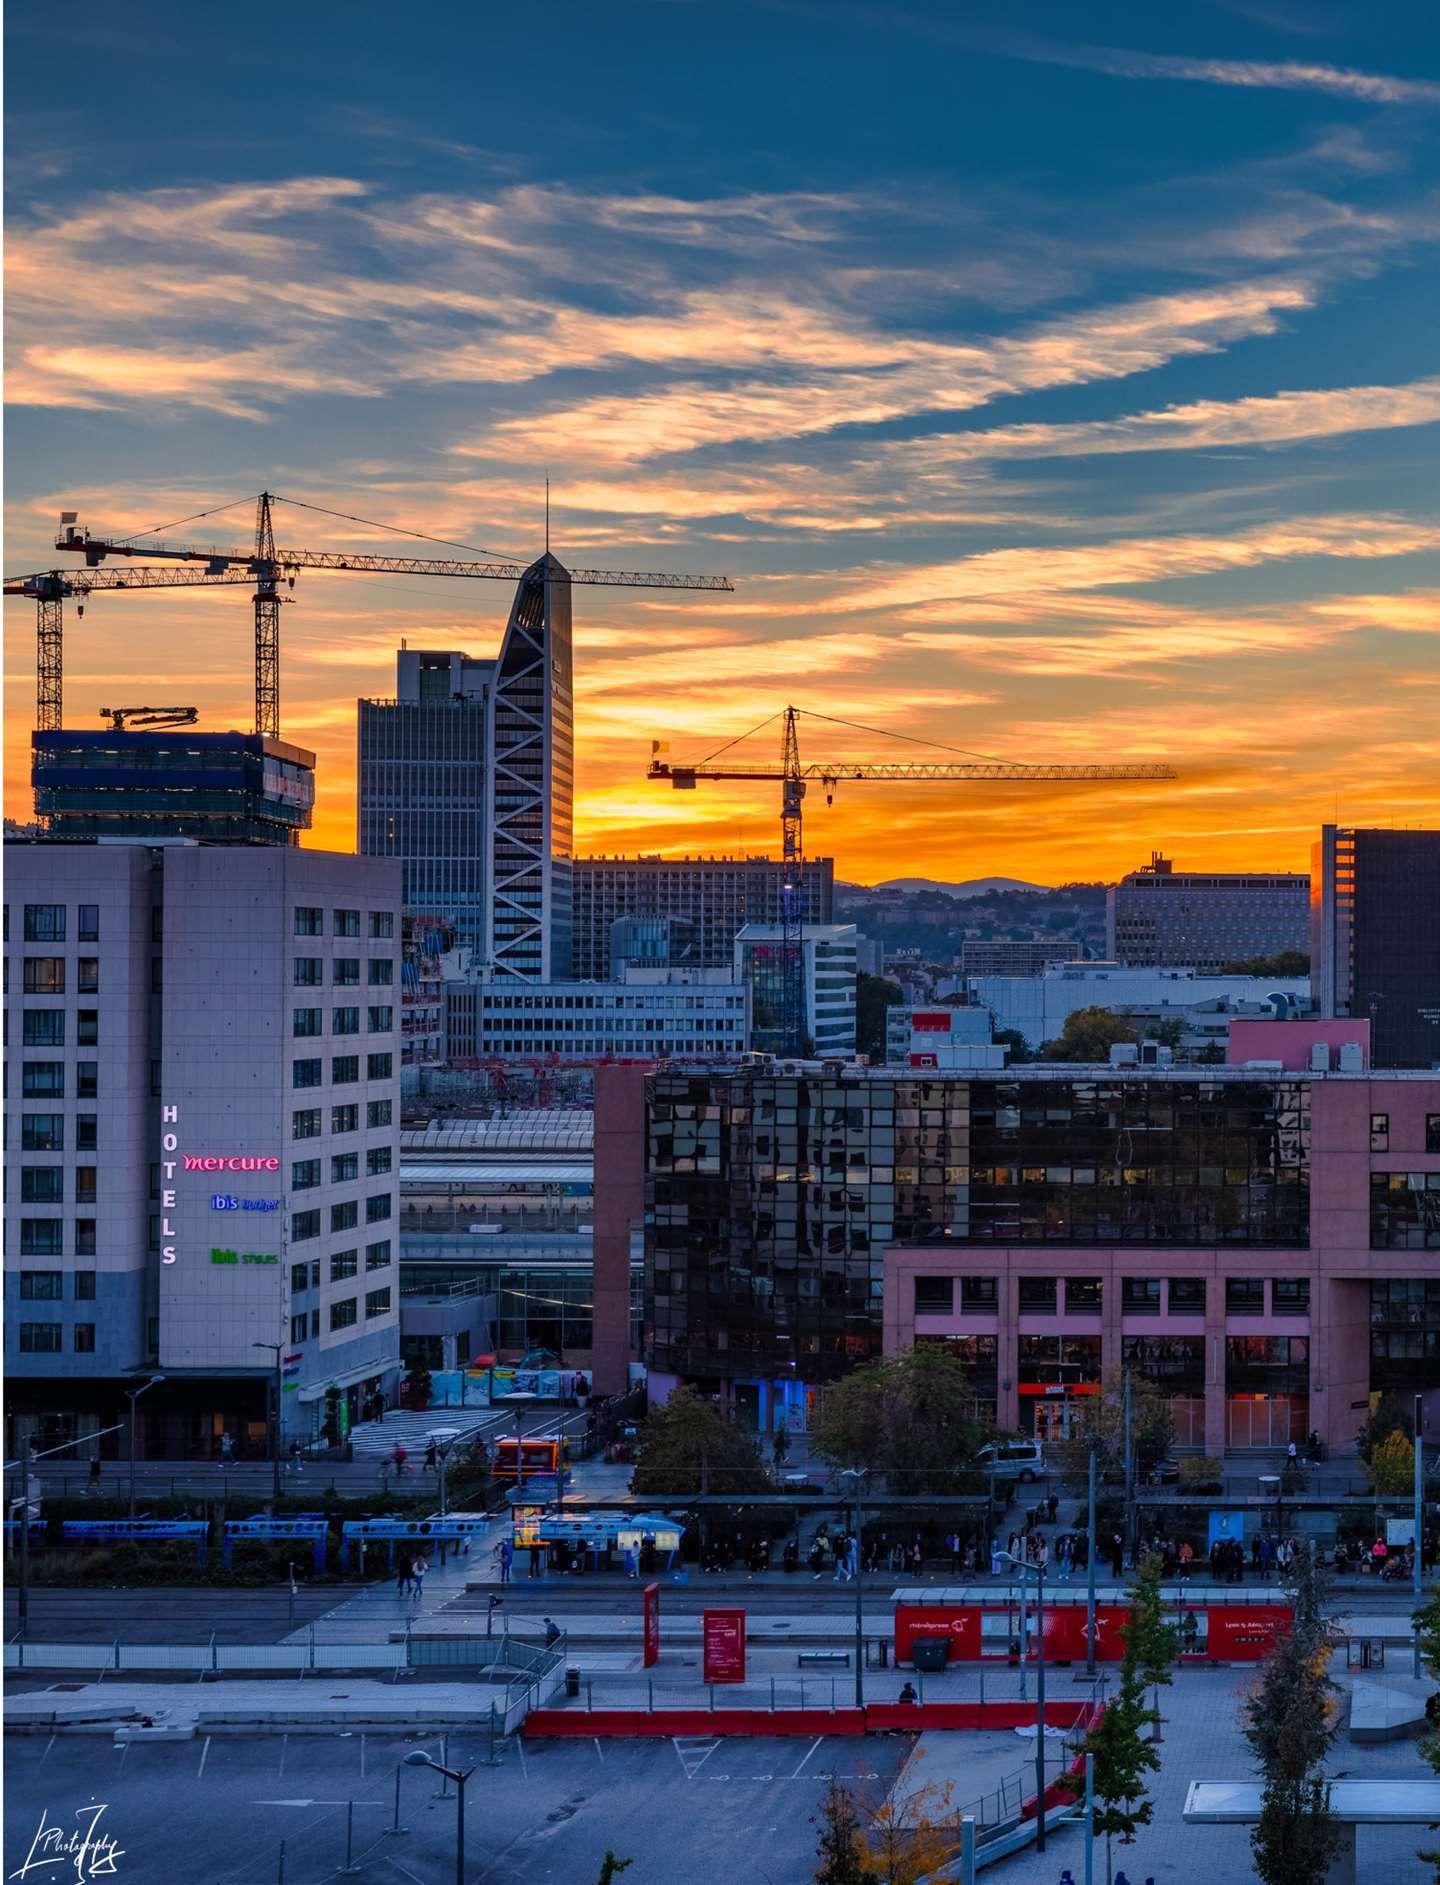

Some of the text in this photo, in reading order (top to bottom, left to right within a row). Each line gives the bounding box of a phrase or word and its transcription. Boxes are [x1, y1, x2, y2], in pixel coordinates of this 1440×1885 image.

[183, 1154, 280, 1172] mercure
[163, 1105, 178, 1265] HOTELS
[211, 1193, 239, 1210] ibis
[211, 1248, 238, 1264] ibis
